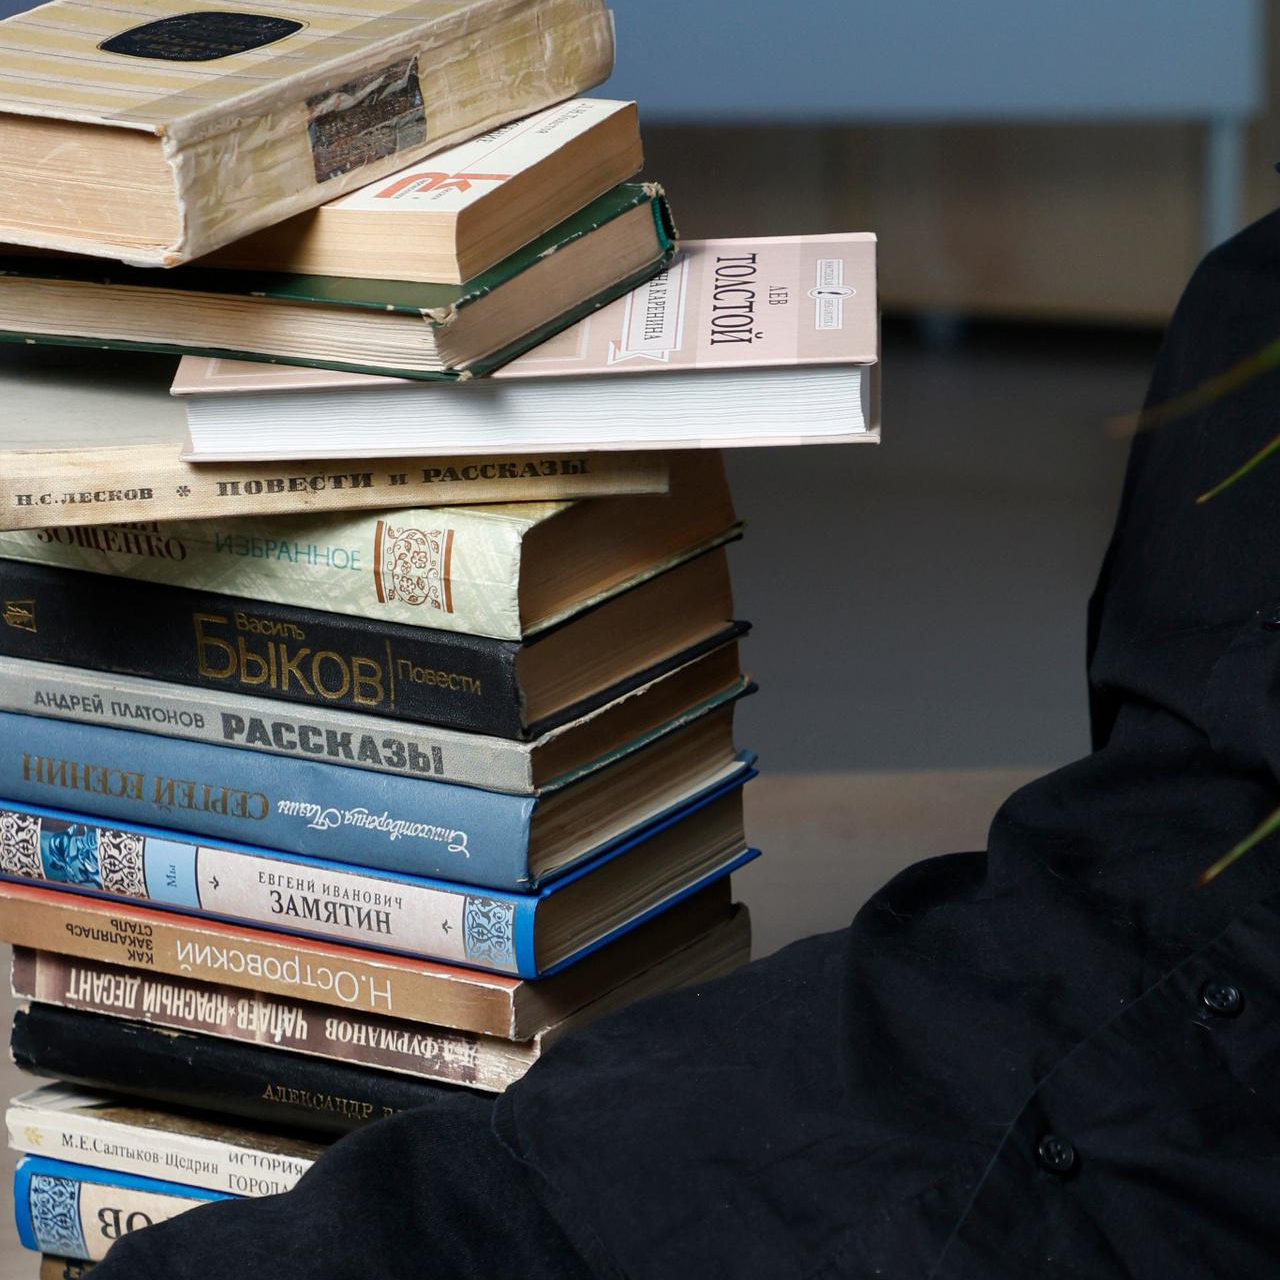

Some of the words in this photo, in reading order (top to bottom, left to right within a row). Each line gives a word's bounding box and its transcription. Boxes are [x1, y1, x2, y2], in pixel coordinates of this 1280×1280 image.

[709, 252, 764, 345] ТОЛСТОЙ
[768, 285, 788, 306] ЛЕВ
[644, 289, 667, 341] КАРЕНИНА
[216, 473, 374, 497] ПОВЕСТИ
[421, 458, 590, 484] РАССКАЗЫ
[37, 526, 187, 561] ЗОЩЕНКО
[215, 532, 362, 571] ИЗБРАННОЕ
[234, 612, 305, 640] Василь
[397, 659, 482, 696] Повести
[34, 691, 103, 714] АНДРЕЙ
[111, 701, 205, 729] ПЛАТОНОВ
[220, 712, 444, 774] РАССКАЗЫ
[21, 753, 144, 801] ЕСЕНИН
[154, 776, 269, 820] СЕРГЕЙ
[166, 864, 176, 888] Мы
[270, 890, 393, 935] ЗАМЯТИН
[322, 883, 403, 910] ИВАНОВИЧ
[65, 924, 153, 950] ЗАКАЛЯЛАСЬ
[110, 919, 153, 935] СТАЛЬ
[127, 948, 154, 964] КАК
[65, 968, 141, 1007] ДЕСАНТ
[142, 982, 228, 1024] КРАСНЫЙ
[237, 998, 307, 1041] ЧАПАЕВ
[263, 1084, 373, 1119] АЛЕКСАНДР
